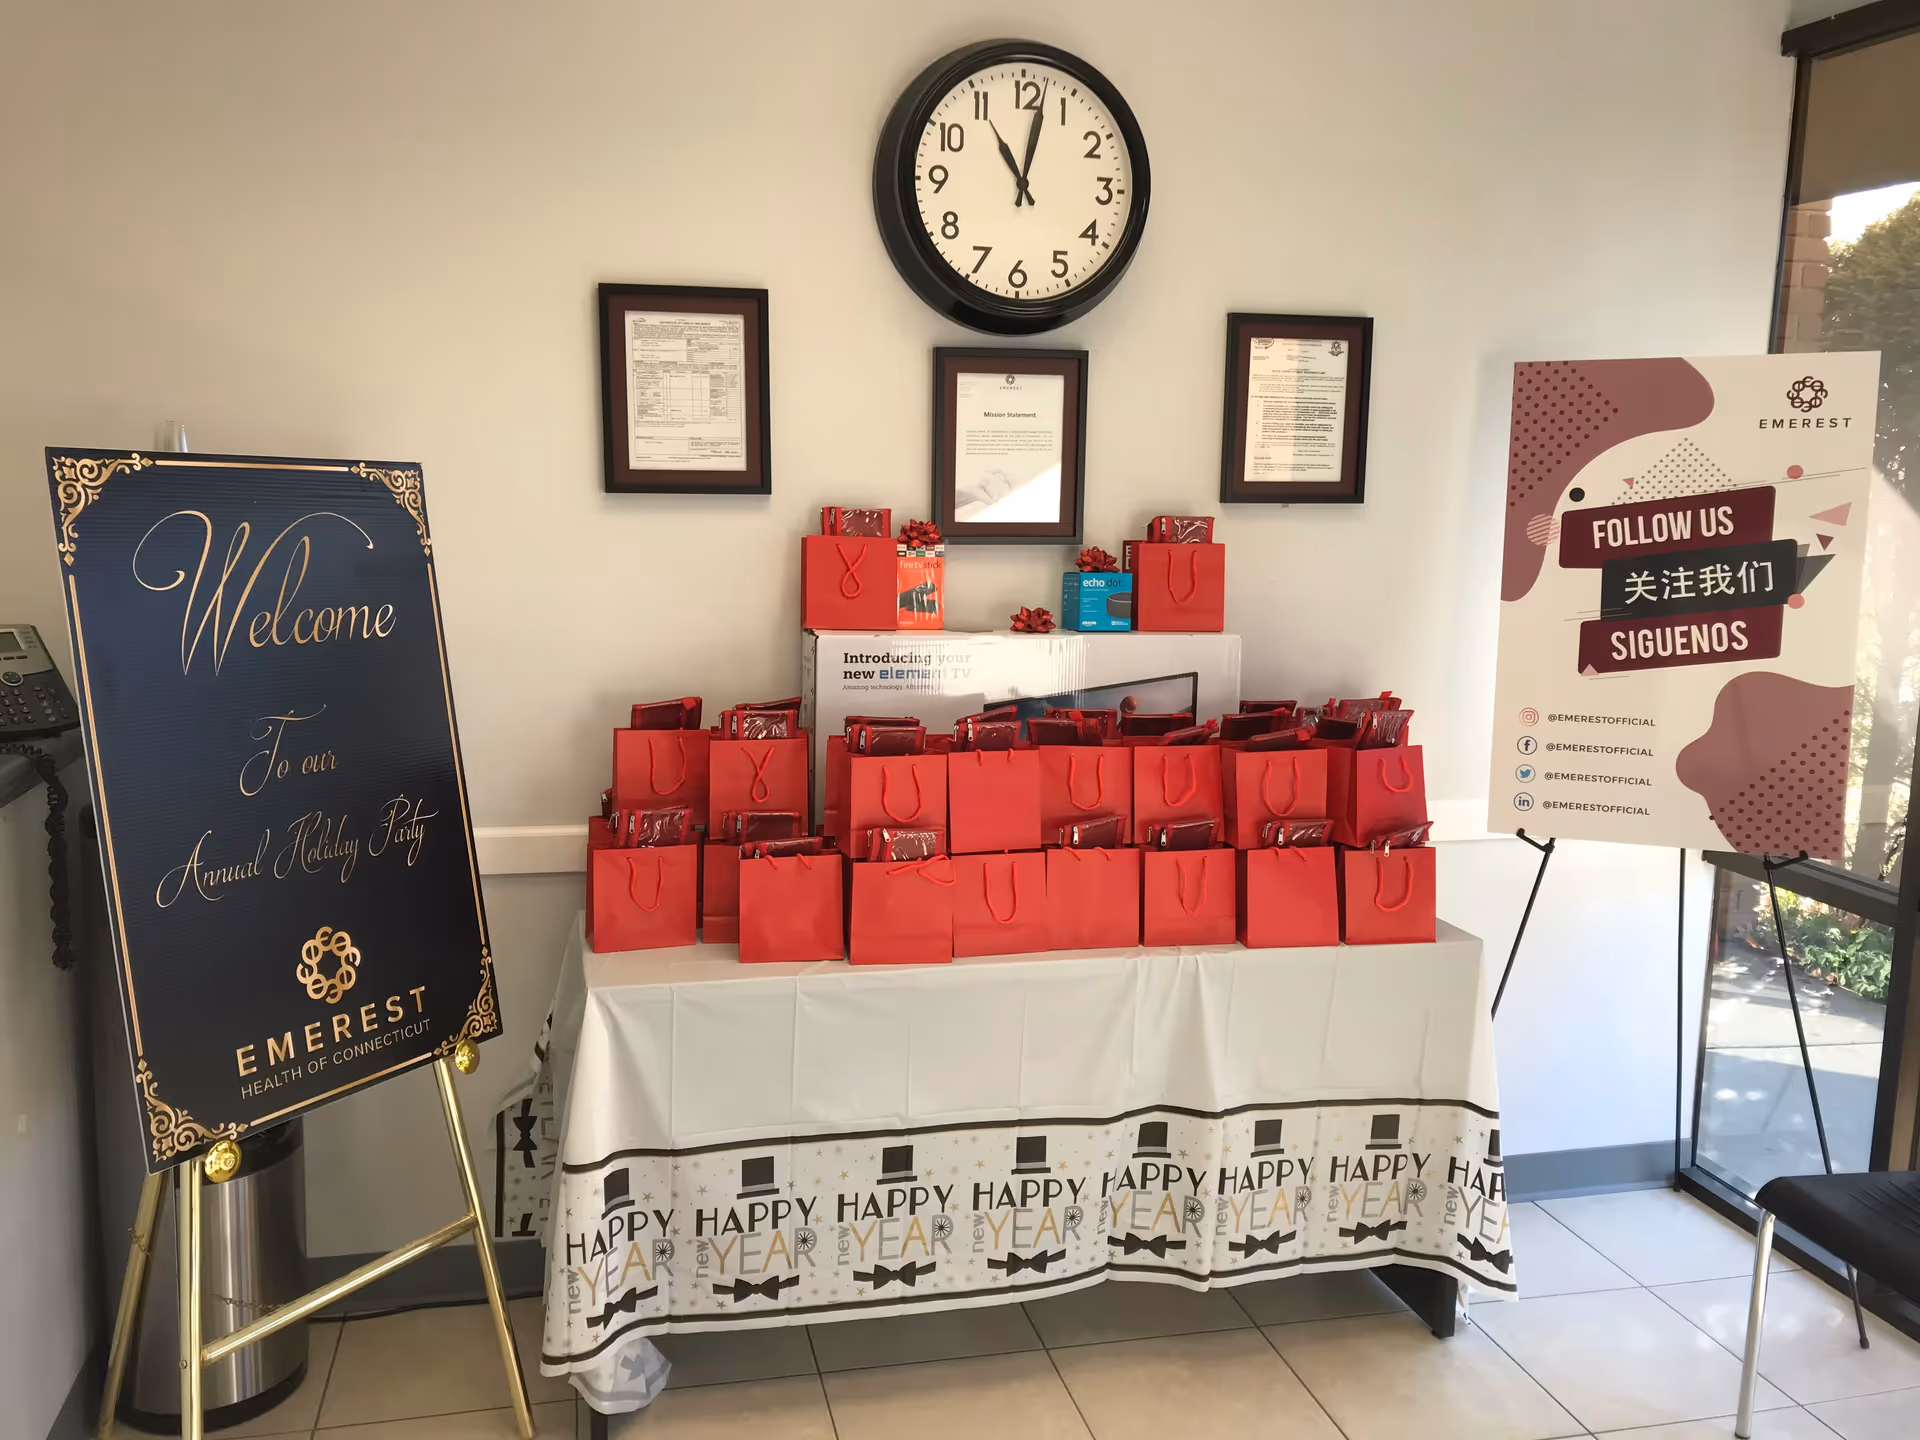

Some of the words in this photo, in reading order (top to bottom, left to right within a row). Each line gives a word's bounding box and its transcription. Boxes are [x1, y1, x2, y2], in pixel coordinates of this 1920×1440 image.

[974, 91, 989, 121] 11
[1015, 80, 1041, 110] 12
[1060, 97, 1067, 126] 1
[940, 122, 964, 152] 10
[1083, 131, 1101, 159] 2
[928, 165, 949, 193] 9
[1095, 176, 1113, 205] 3
[941, 211, 960, 239] 8
[1078, 219, 1099, 246] 4
[971, 246, 993, 274] 7
[1008, 260, 1027, 288] 6
[1051, 250, 1068, 278] 5
[1759, 417, 1852, 429] EMEREST
[1592, 510, 1692, 549] FOLLOW
[1700, 506, 1734, 537] US
[923, 561, 942, 569] stick
[133, 510, 396, 676] Welcome
[1083, 578, 1105, 587] echo
[1106, 578, 1121, 587] dot
[1624, 561, 1774, 605] 关注我们
[1611, 620, 1749, 661] SIGUENOS
[843, 652, 932, 665] Introducing
[938, 655, 971, 665] your
[843, 670, 875, 679] new
[952, 668, 971, 678] TV
[1548, 713, 1656, 727] @EMERESTOFFICIAL
[239, 704, 326, 796] To
[302, 750, 338, 775] our
[1546, 743, 1654, 756] @EMERESTOFFICIAL
[1544, 772, 1652, 786] @EMERESTOFFICIAL
[1542, 801, 1650, 816] @EMERESTOFFICIAL
[156, 829, 270, 908] Annual
[274, 811, 359, 883] Holiday
[368, 794, 439, 866] Party
[236, 985, 426, 1077] EMEREST
[241, 1066, 302, 1100] HEALTH
[307, 1056, 328, 1074] OF
[332, 1018, 431, 1065] CONNECTICUT
[1101, 1162, 1207, 1198] HAPPY
[1218, 1157, 1314, 1195] HAPPY
[1329, 1152, 1432, 1183] HAPPY
[837, 1184, 954, 1223] HAPPY
[972, 1176, 1087, 1211] HAPPY
[1326, 1185, 1341, 1223] new
[1338, 1178, 1428, 1221] YEAR
[1444, 1185, 1460, 1226] new
[696, 1196, 817, 1237] HAPPY
[1097, 1199, 1110, 1235] new
[1108, 1190, 1206, 1238] YEAR
[1215, 1196, 1230, 1236] new
[1228, 1185, 1312, 1233] YEAR
[566, 1209, 675, 1266] HAPPY
[837, 1224, 850, 1266] new
[849, 1213, 954, 1263] YEAR
[972, 1213, 985, 1254] new
[984, 1205, 1084, 1250] YEAR
[696, 1239, 709, 1279] new
[708, 1227, 818, 1275] YEAR
[567, 1268, 582, 1315] new
[577, 1238, 675, 1307] YEAR
